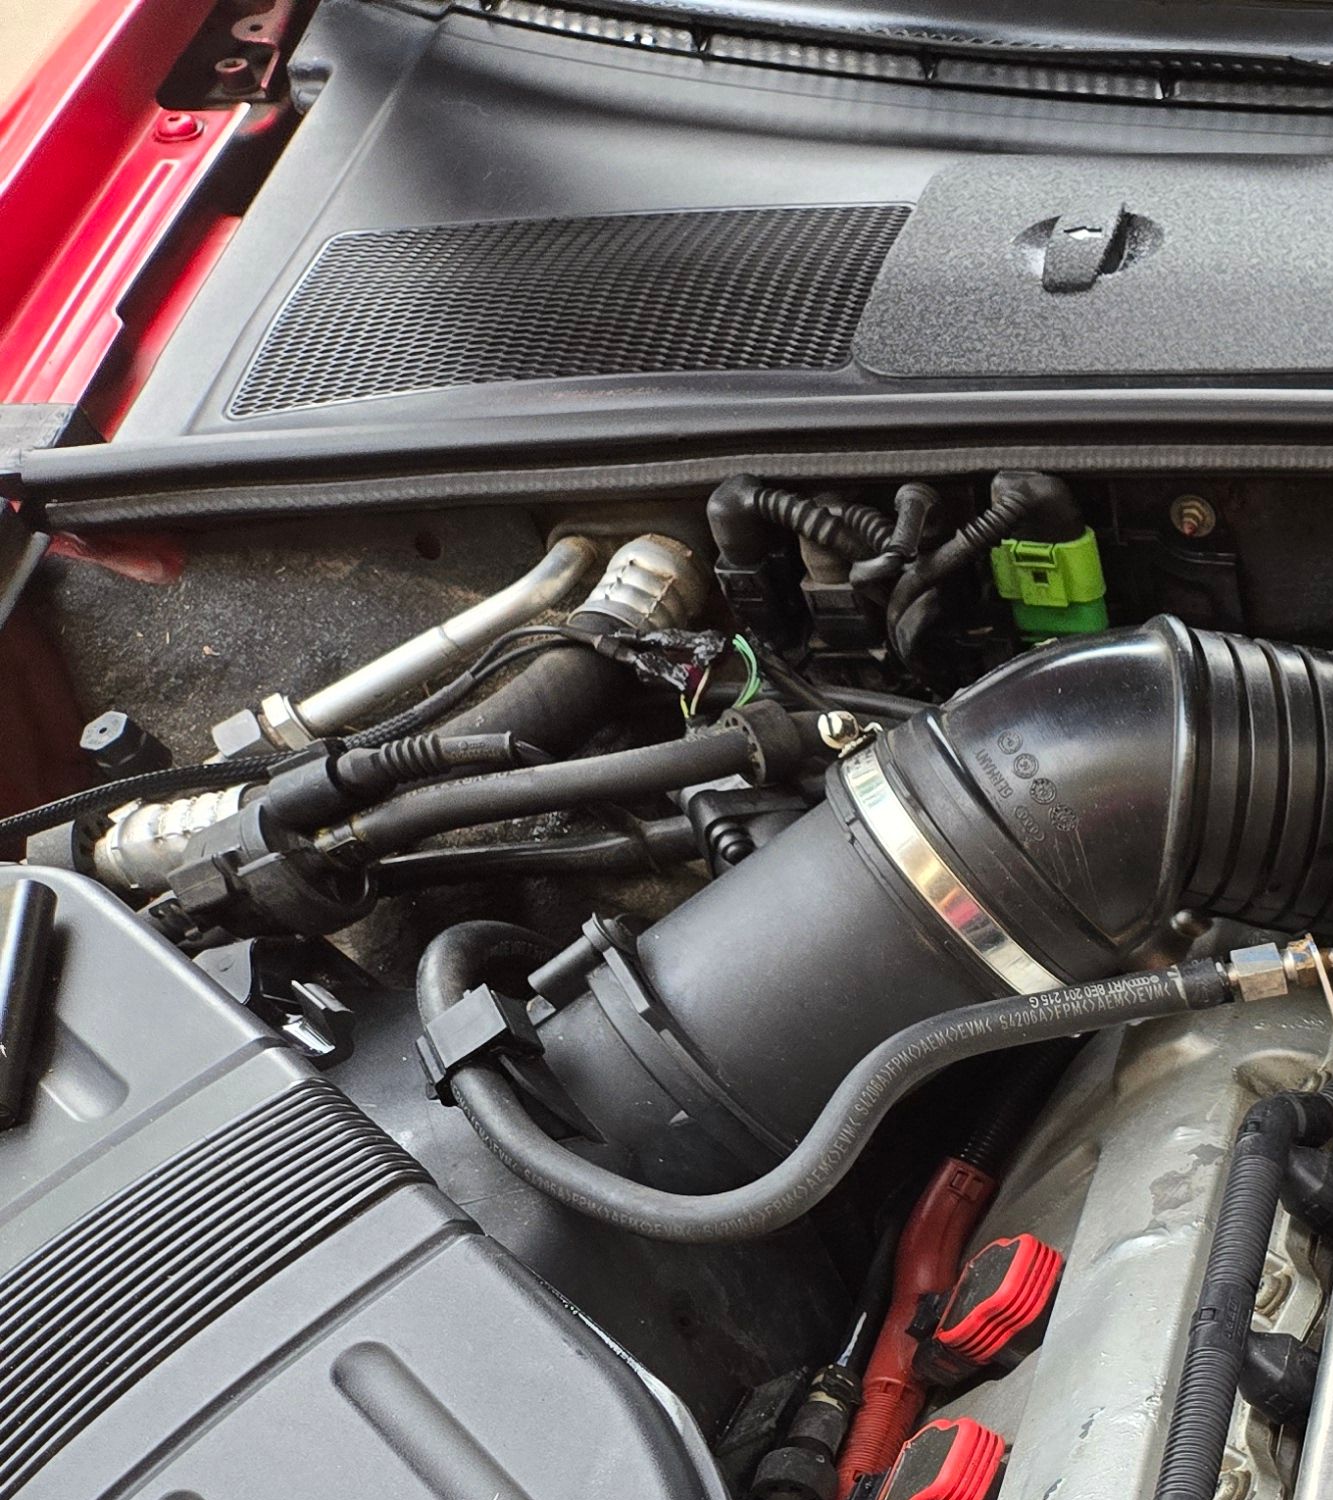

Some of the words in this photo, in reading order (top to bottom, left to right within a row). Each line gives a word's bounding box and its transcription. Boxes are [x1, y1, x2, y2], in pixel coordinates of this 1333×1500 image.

[974, 749, 1014, 799] GERMANY
[1064, 988, 1083, 1000] 201
[1084, 984, 1106, 997] 8E0
[1028, 997, 1039, 1008] G
[1041, 993, 1061, 1006] 215
